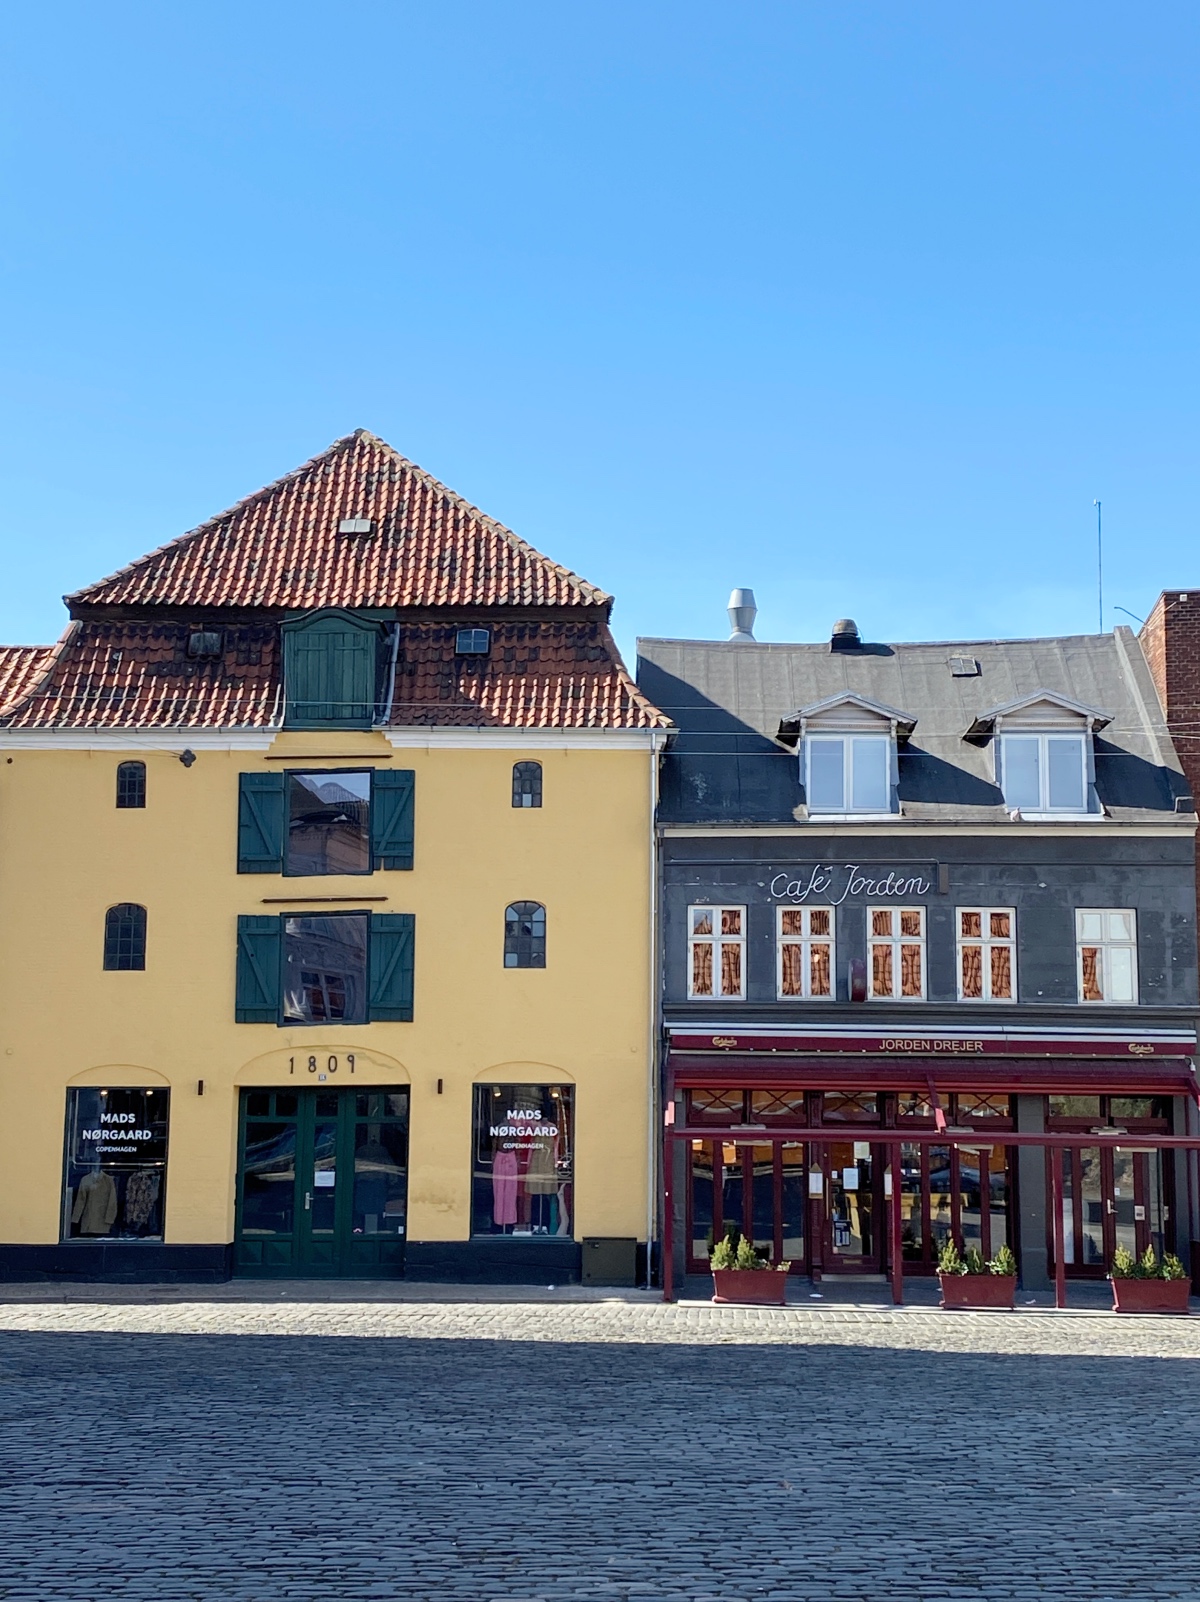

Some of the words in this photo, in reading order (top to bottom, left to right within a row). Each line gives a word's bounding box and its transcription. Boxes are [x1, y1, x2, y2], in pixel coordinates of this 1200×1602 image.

[771, 865, 833, 903] Café
[830, 865, 930, 905] Jorden
[879, 1039, 931, 1050] JORDEN
[933, 1040, 984, 1051] DREJER
[289, 1054, 355, 1074] 1809
[100, 1113, 136, 1124] MADS
[506, 1109, 542, 1120] MADS
[82, 1129, 152, 1140] NØRGAARD
[489, 1126, 559, 1137] NØRGAARD
[95, 1145, 138, 1153] COPENHAGEN
[502, 1142, 545, 1150] COPENHAGEN
